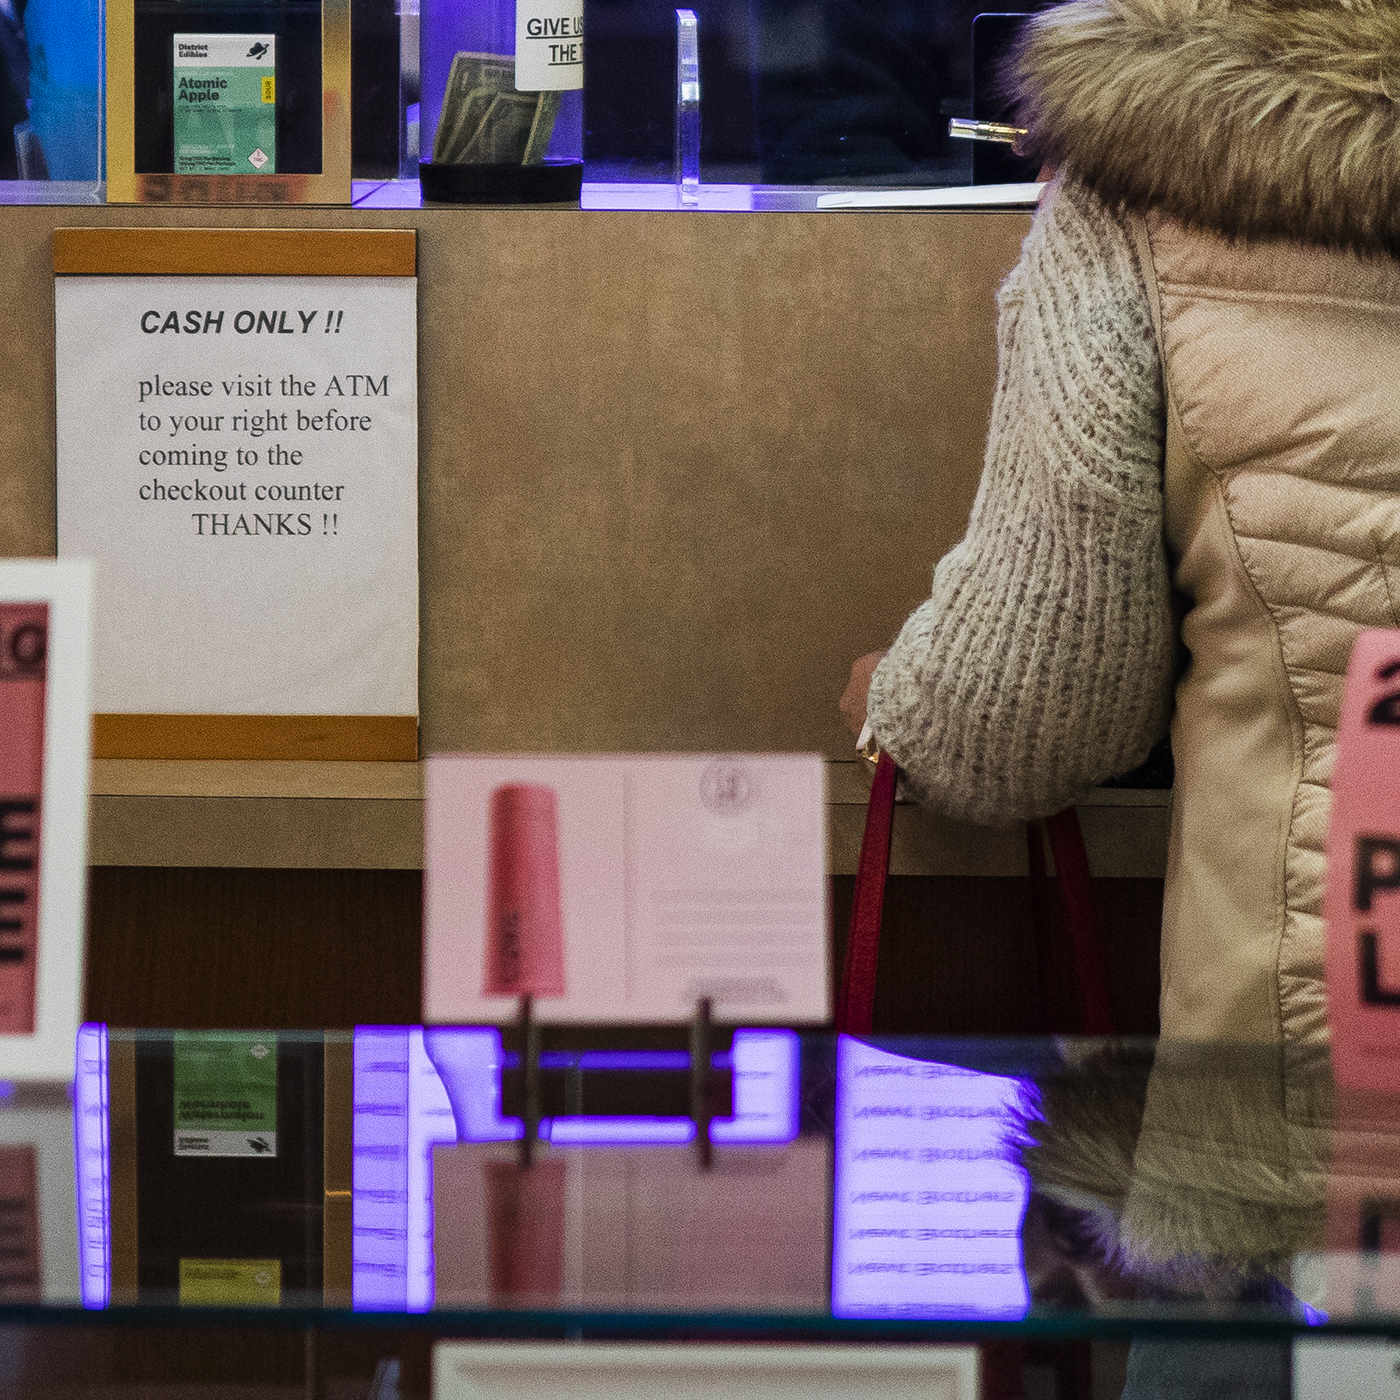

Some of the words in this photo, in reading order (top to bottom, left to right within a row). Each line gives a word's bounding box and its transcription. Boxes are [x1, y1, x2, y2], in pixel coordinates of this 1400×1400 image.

[526, 17, 570, 36] GIVE
[548, 44, 577, 62] THE
[178, 77, 228, 89] Atomic
[178, 89, 220, 103] Apple
[140, 310, 225, 335] CASH
[233, 310, 318, 334] ONLY
[323, 310, 344, 334] !!
[138, 374, 213, 402] please
[221, 374, 272, 397] visit
[280, 374, 317, 397] the
[323, 374, 391, 397] ATM
[139, 413, 161, 431] to
[169, 415, 225, 437] your
[231, 408, 289, 437] right
[296, 408, 373, 431] before
[138, 444, 229, 473] coming
[237, 448, 259, 466] to
[267, 444, 303, 467] the
[138, 478, 247, 501] checkout
[254, 482, 346, 501] counter
[192, 512, 313, 537] THANKS
[321, 512, 340, 536] !!
